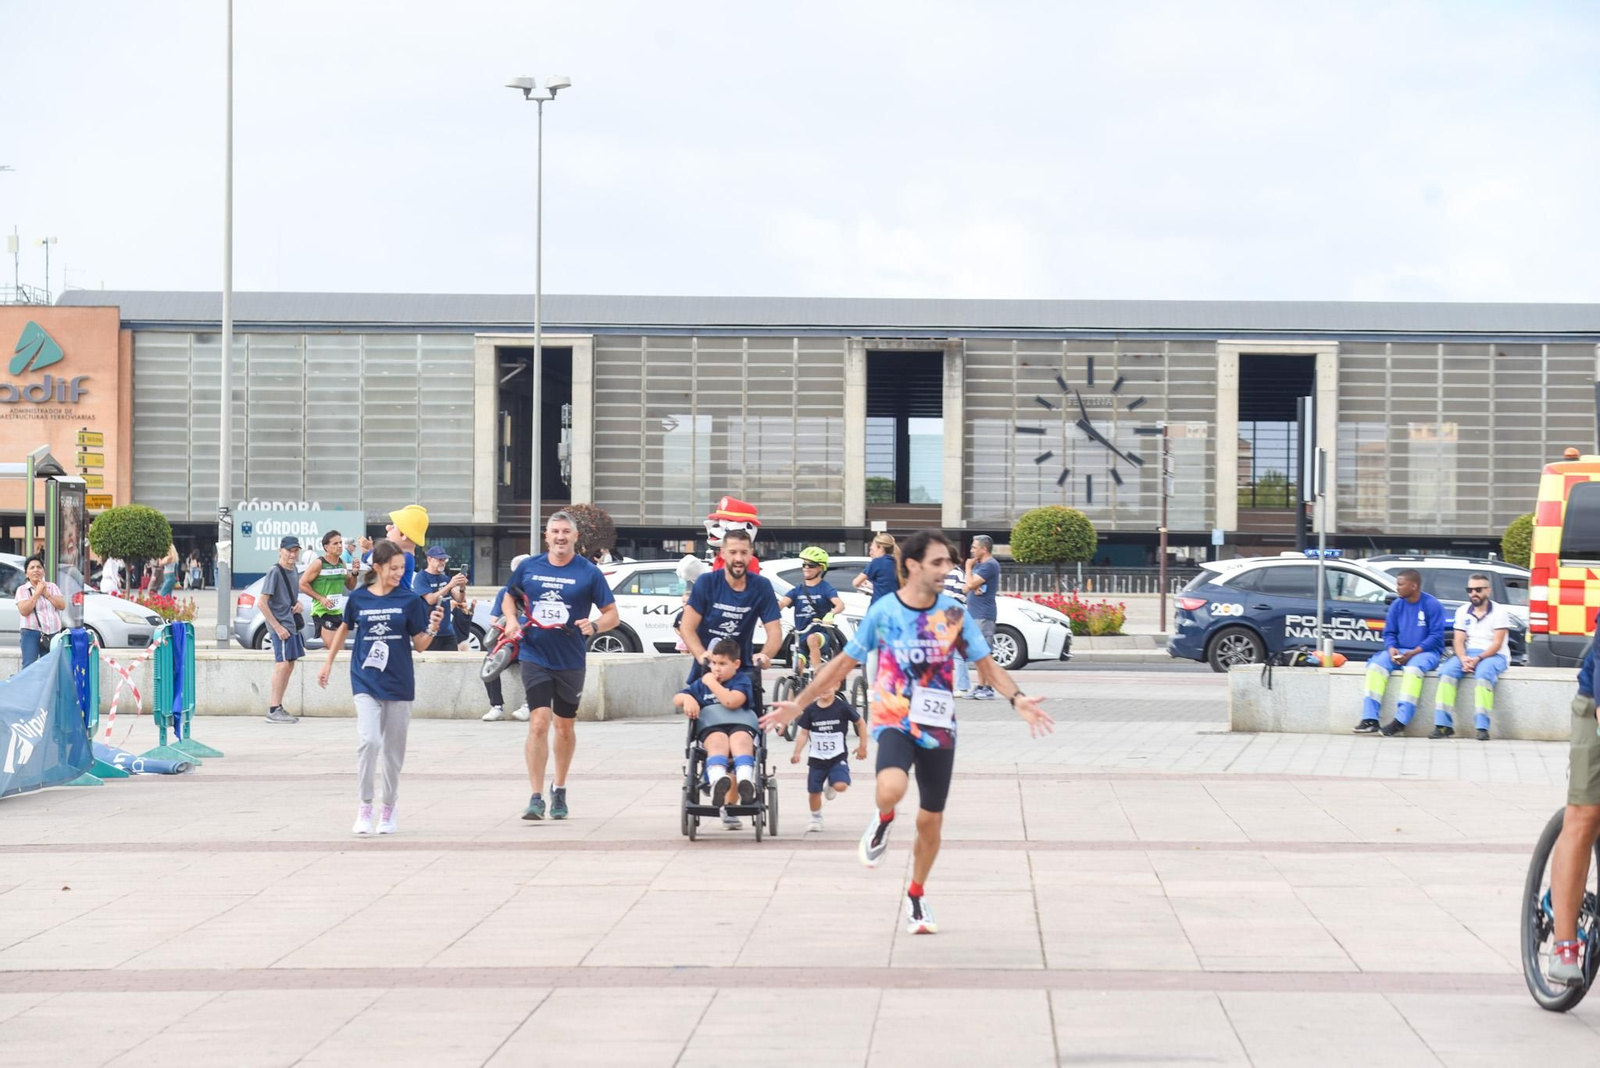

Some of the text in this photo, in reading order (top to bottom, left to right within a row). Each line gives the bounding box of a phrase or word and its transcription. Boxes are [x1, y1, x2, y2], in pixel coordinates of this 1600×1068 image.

[0, 375, 90, 404] adif
[255, 518, 319, 535] CÓRDOBA
[254, 536, 283, 551] JULI
[541, 608, 561, 619] 154
[1285, 614, 1369, 630] POLICIA
[1285, 626, 1385, 642] NACONAL
[367, 648, 385, 661] 156
[894, 648, 925, 664] NO
[923, 699, 947, 715] 526
[816, 741, 836, 752] 153
